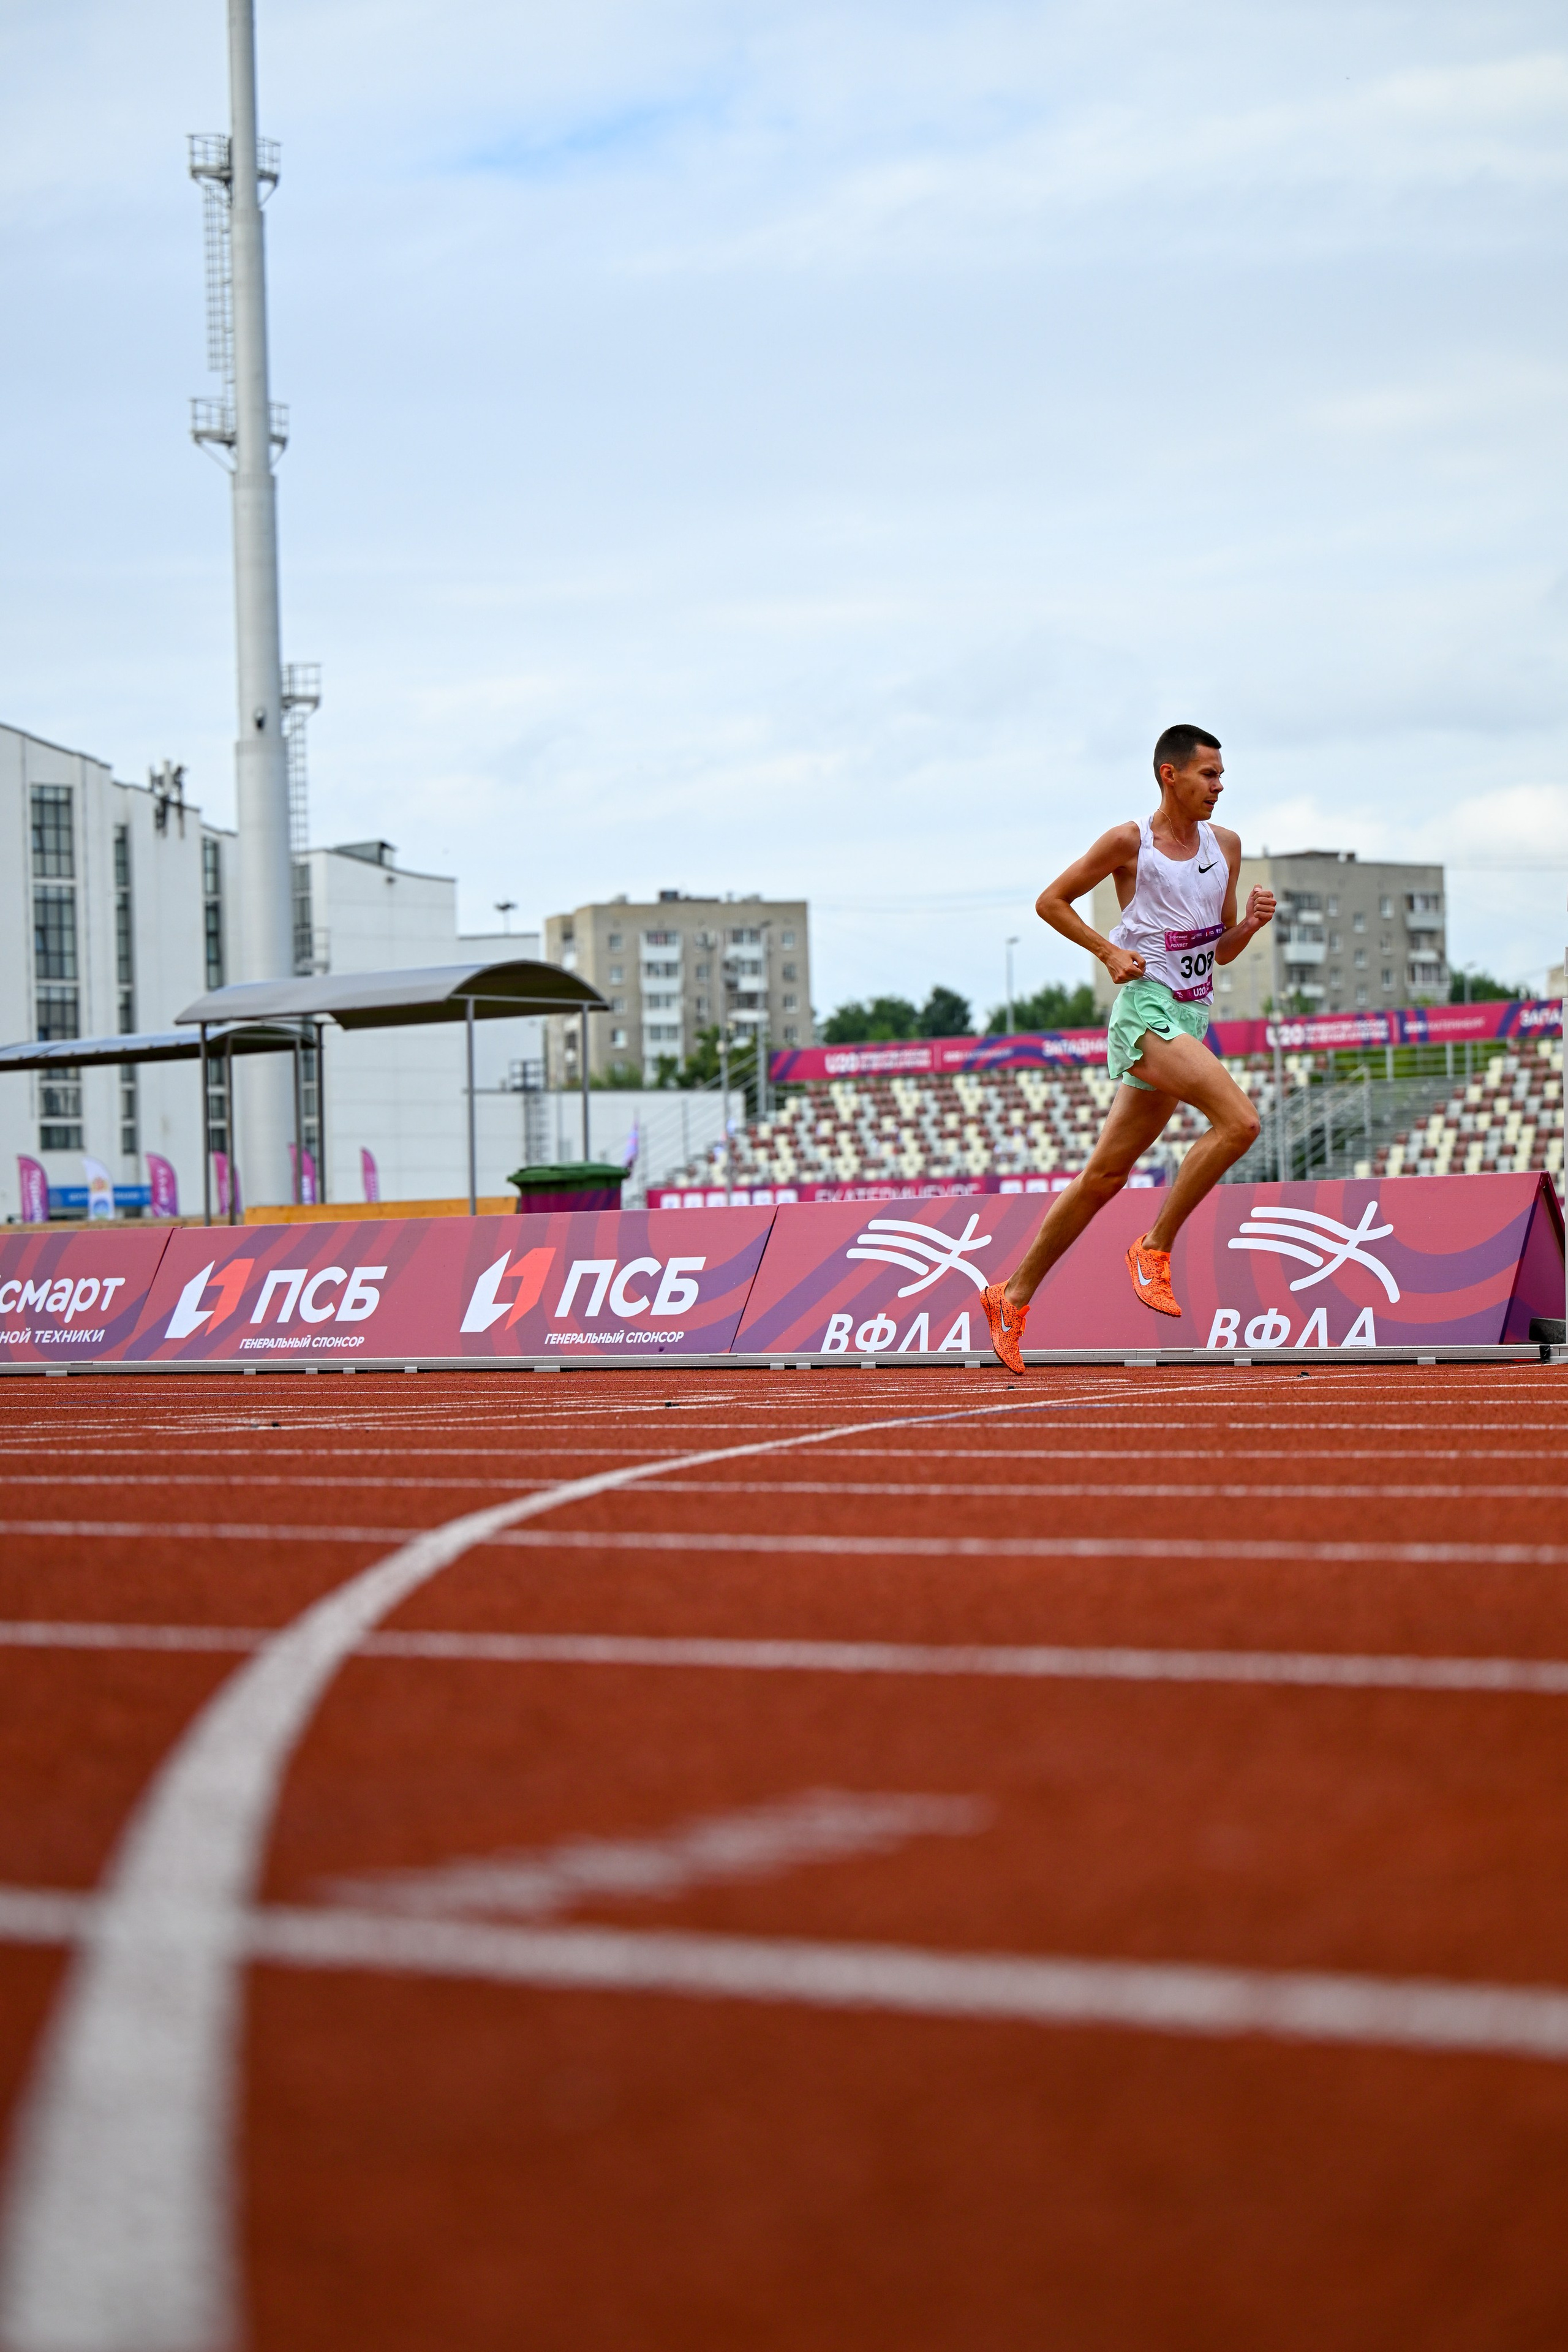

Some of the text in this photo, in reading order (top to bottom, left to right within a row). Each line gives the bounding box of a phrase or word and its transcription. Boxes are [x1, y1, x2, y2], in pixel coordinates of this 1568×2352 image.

[1193, 987, 1206, 997] U20
[0, 1275, 126, 1323] смарт
[250, 1266, 388, 1323] ПСБ
[554, 1257, 706, 1317] ПСБ
[0, 1327, 105, 1344] НОЙ ТЕХНИКИ
[239, 1335, 364, 1349] ГЕНЕРАЛЬНЫЙ СПОНСОР
[545, 1330, 684, 1344] ГЕНЕРАЛЬНЫЙ СПОНСОР
[820, 1312, 970, 1352] ВФЛА
[1206, 1307, 1376, 1349] ВФЛА
